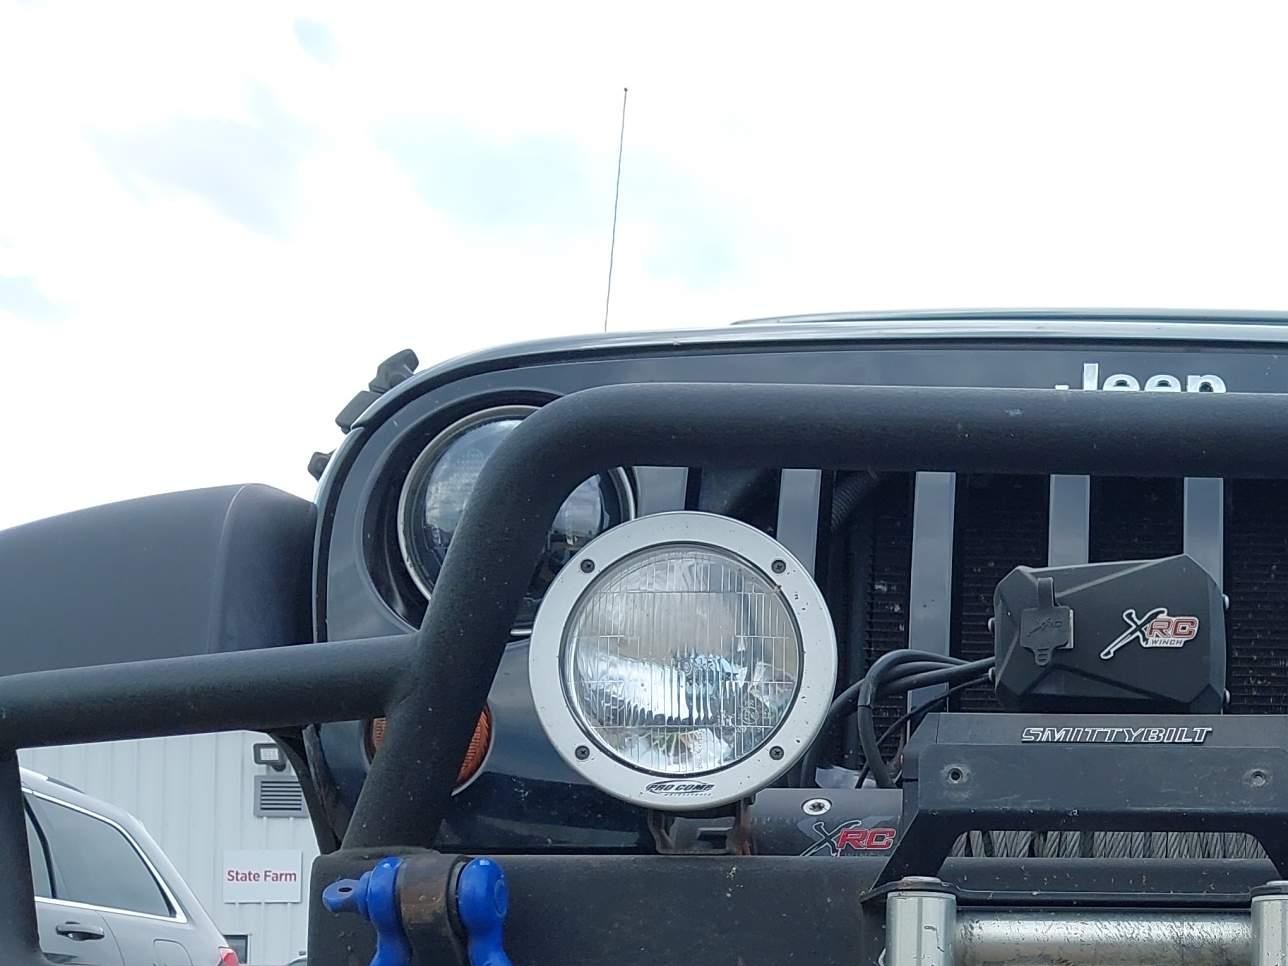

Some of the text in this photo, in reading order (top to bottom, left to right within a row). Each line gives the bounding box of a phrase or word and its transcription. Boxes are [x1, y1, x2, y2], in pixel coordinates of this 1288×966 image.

[1100, 607, 1200, 660] XRC
[1151, 639, 1185, 647] WINCH
[1021, 727, 1213, 743] SMITTYBILT
[801, 820, 897, 856] XRC
[227, 870, 297, 882] State Farm
